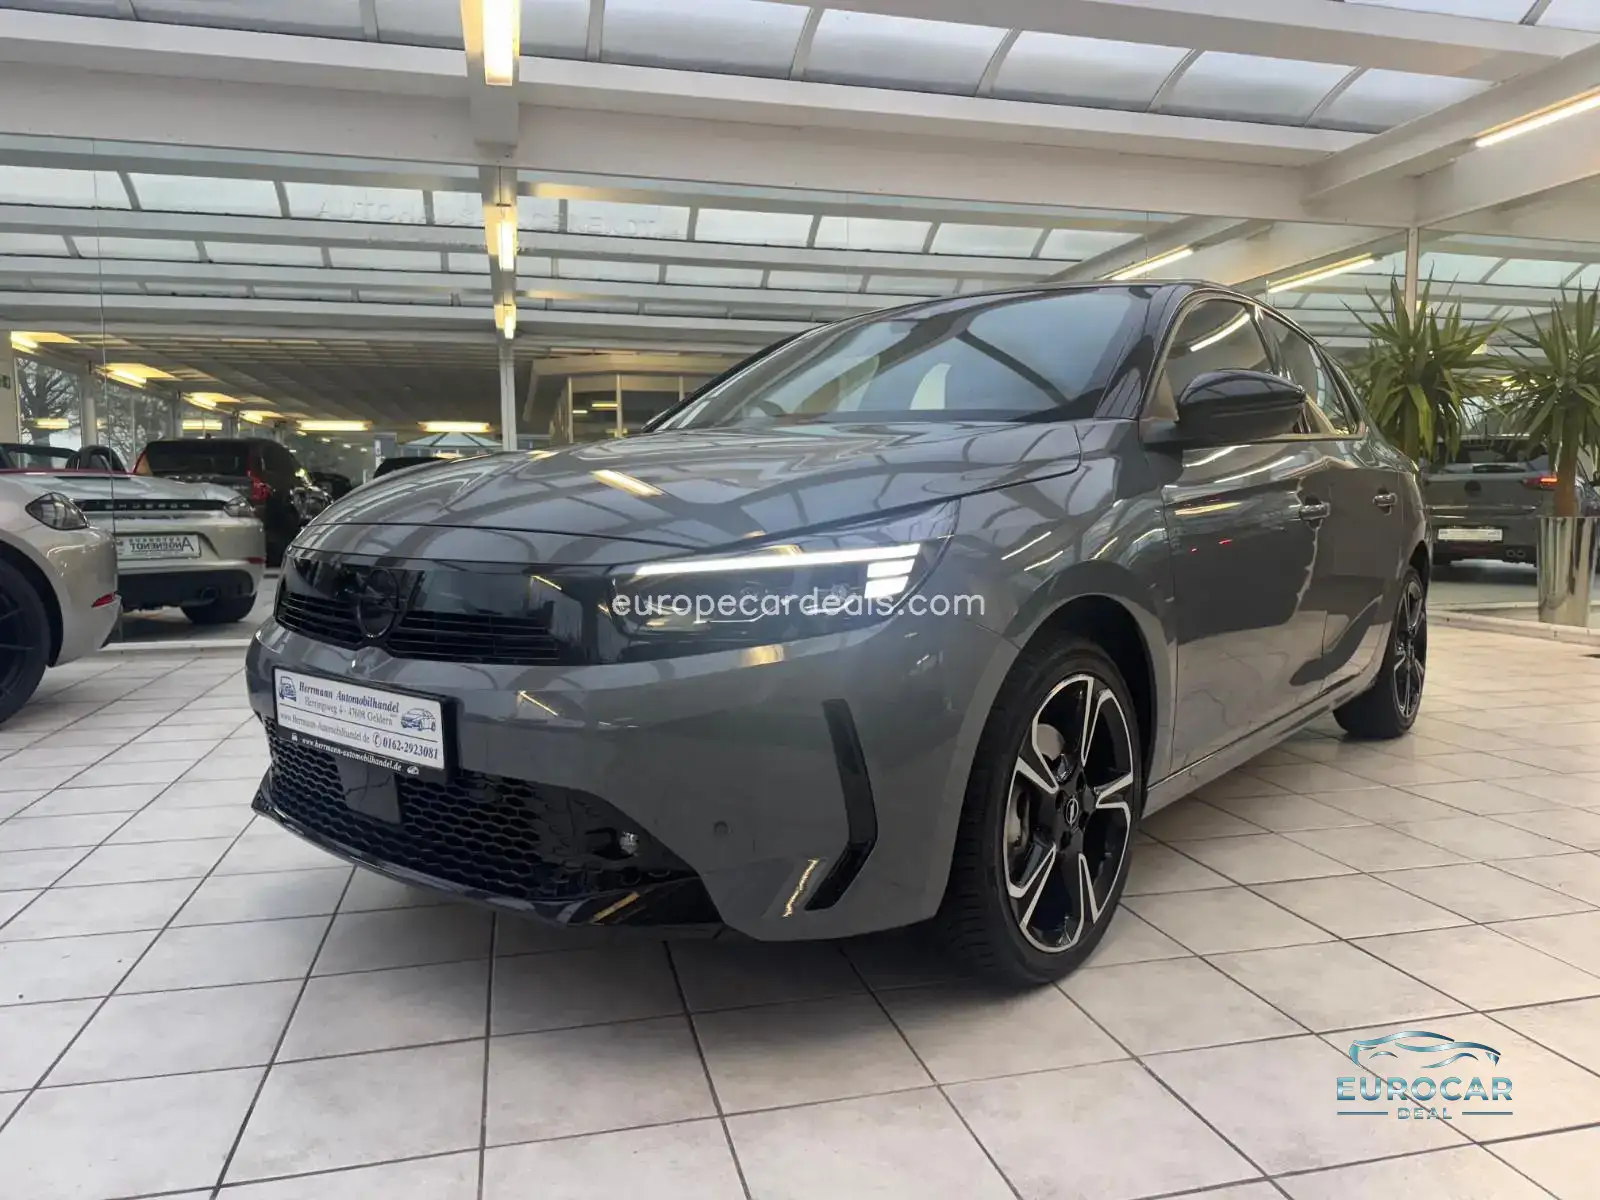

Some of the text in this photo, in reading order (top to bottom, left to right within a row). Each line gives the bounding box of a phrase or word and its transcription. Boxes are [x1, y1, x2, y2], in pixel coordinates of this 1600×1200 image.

[299, 681, 400, 713] Herrmann Automobilhandel
[302, 738, 402, 771] www.herrmann-automobilhandel.de
[382, 736, 438, 760] 0162-2923081
